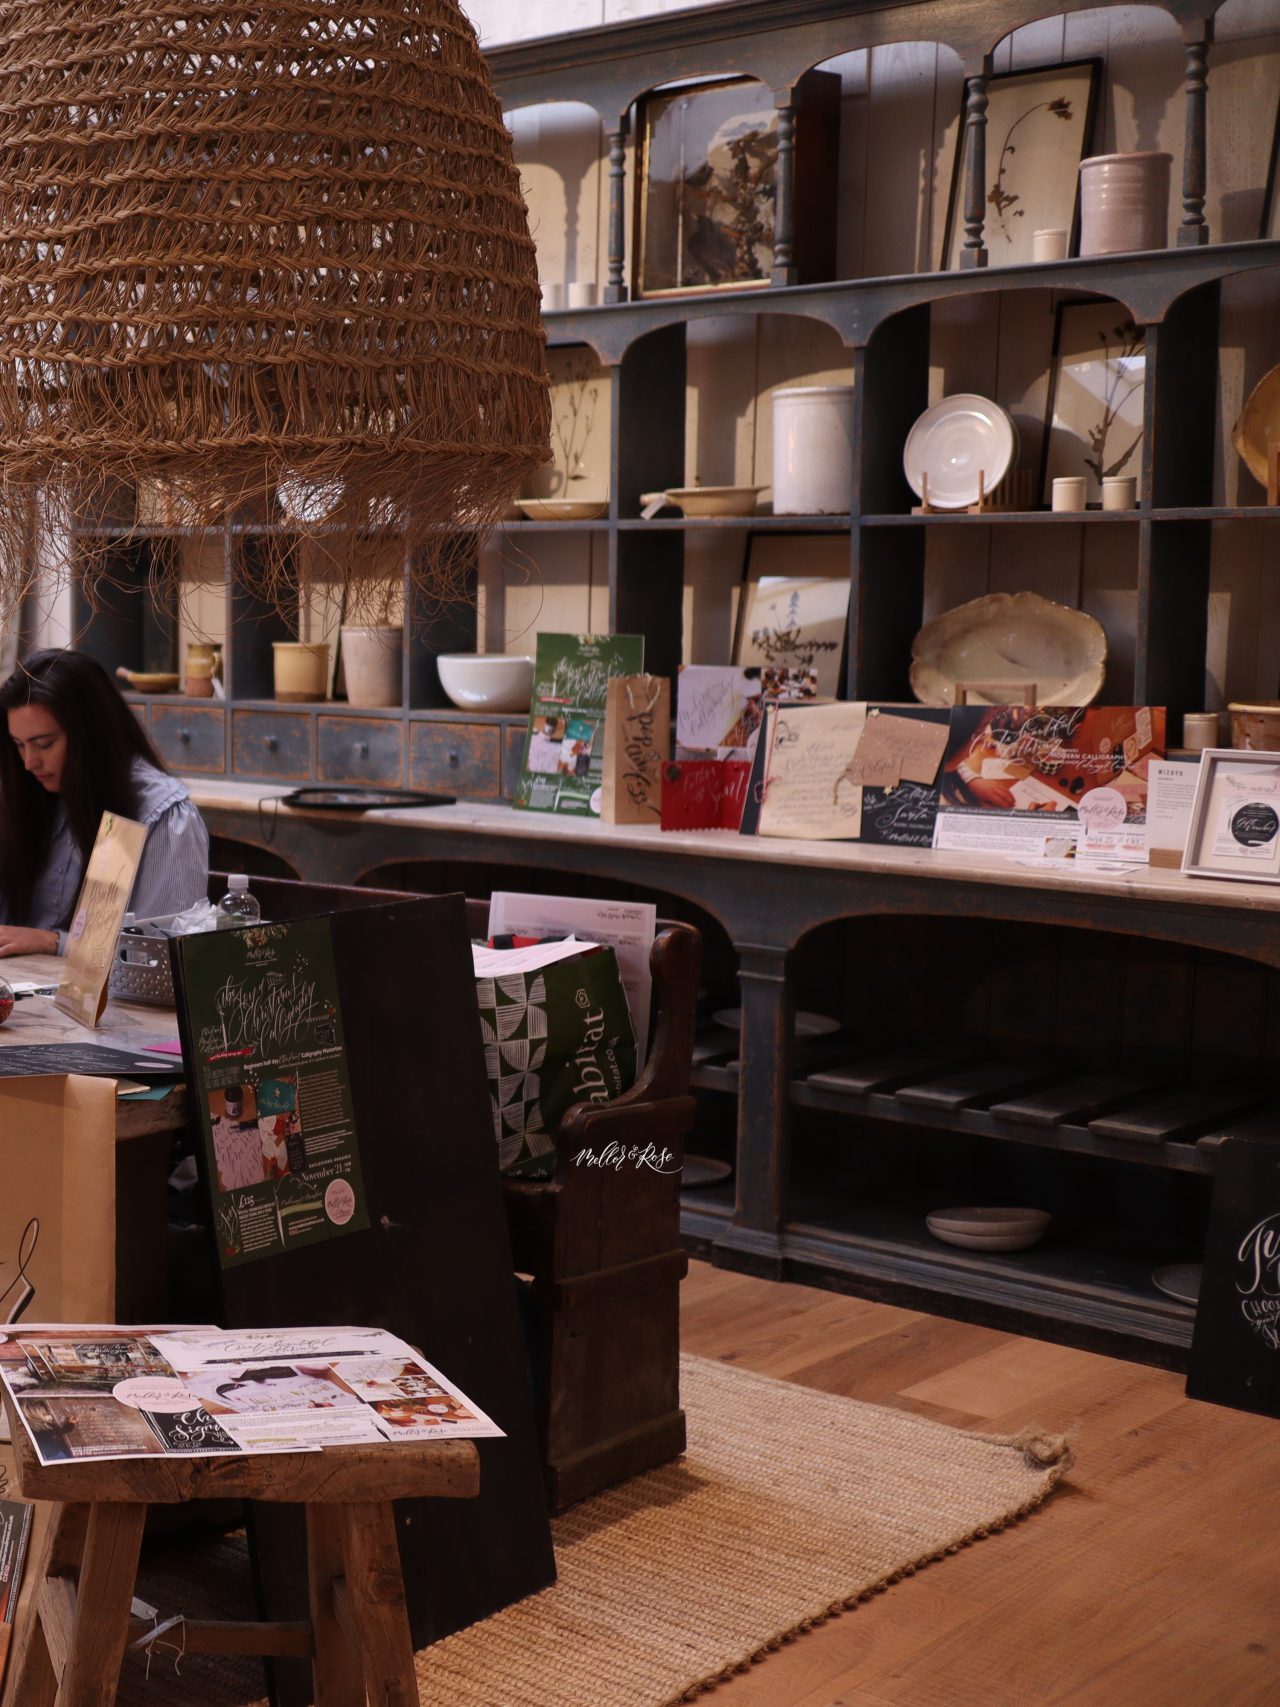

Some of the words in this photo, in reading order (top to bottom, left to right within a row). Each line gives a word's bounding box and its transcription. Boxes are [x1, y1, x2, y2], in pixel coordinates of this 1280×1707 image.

[1051, 752, 1080, 761] MODERN
[573, 1006, 610, 1105] abitat
[301, 1166, 334, 1182] November
